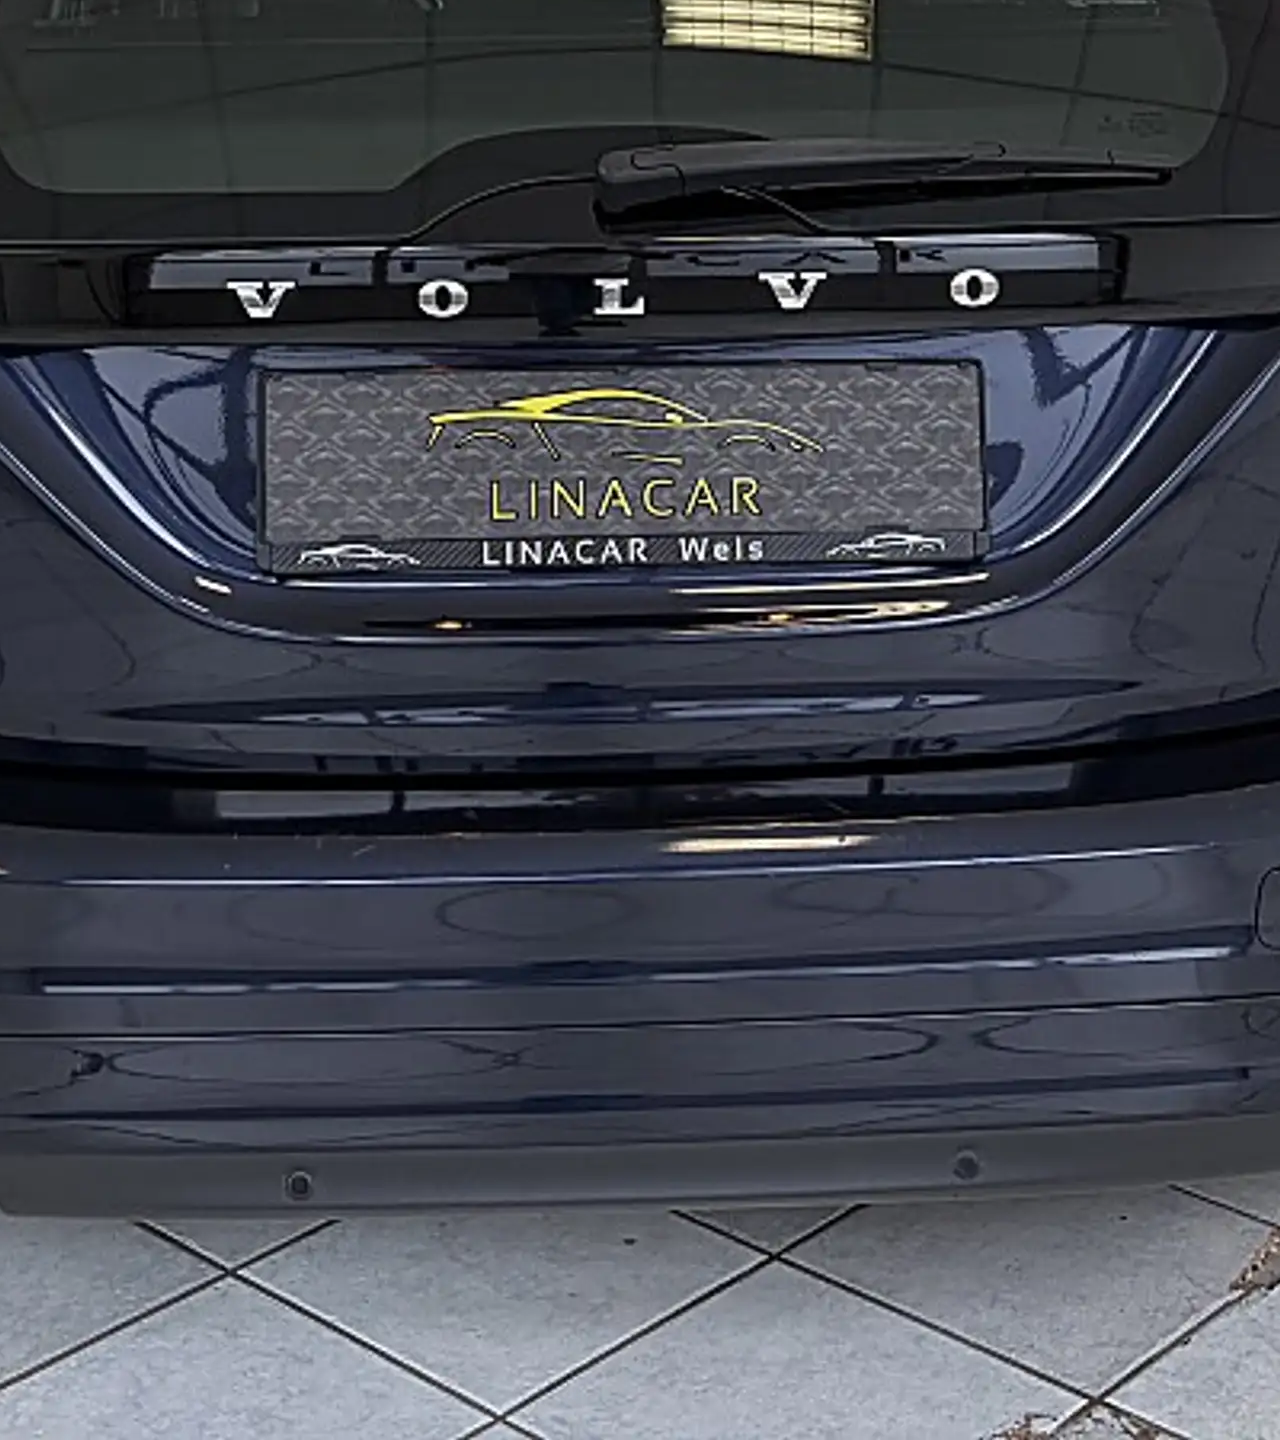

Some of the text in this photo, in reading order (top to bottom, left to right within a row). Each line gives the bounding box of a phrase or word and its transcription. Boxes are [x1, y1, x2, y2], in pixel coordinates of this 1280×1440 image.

[225, 267, 1002, 320] VOLVO
[490, 476, 762, 520] LINACAR
[481, 534, 764, 566] LINACAR Wels
